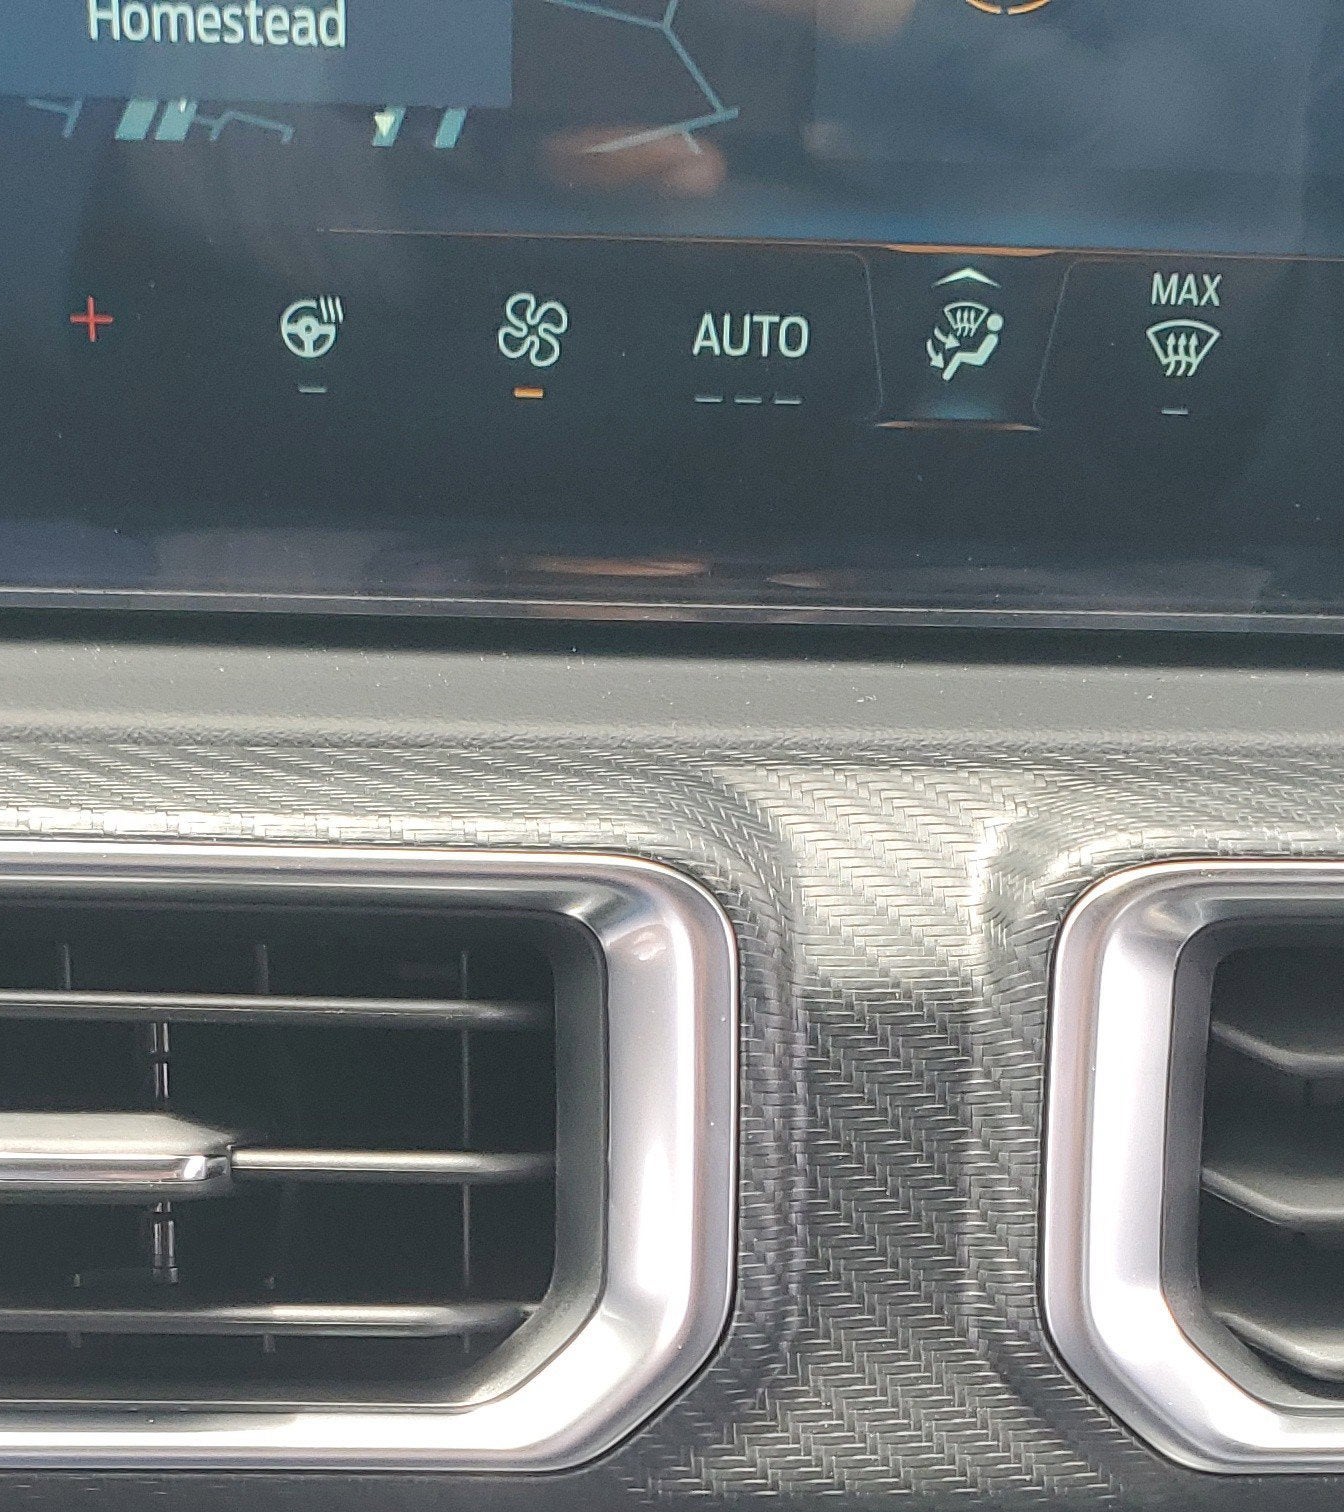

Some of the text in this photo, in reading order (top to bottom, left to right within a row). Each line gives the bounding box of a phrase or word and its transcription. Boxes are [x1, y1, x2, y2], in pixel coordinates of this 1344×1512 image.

[86, 0, 347, 47] Homestead
[1151, 272, 1222, 307] MAX
[692, 314, 809, 359] AUTO
